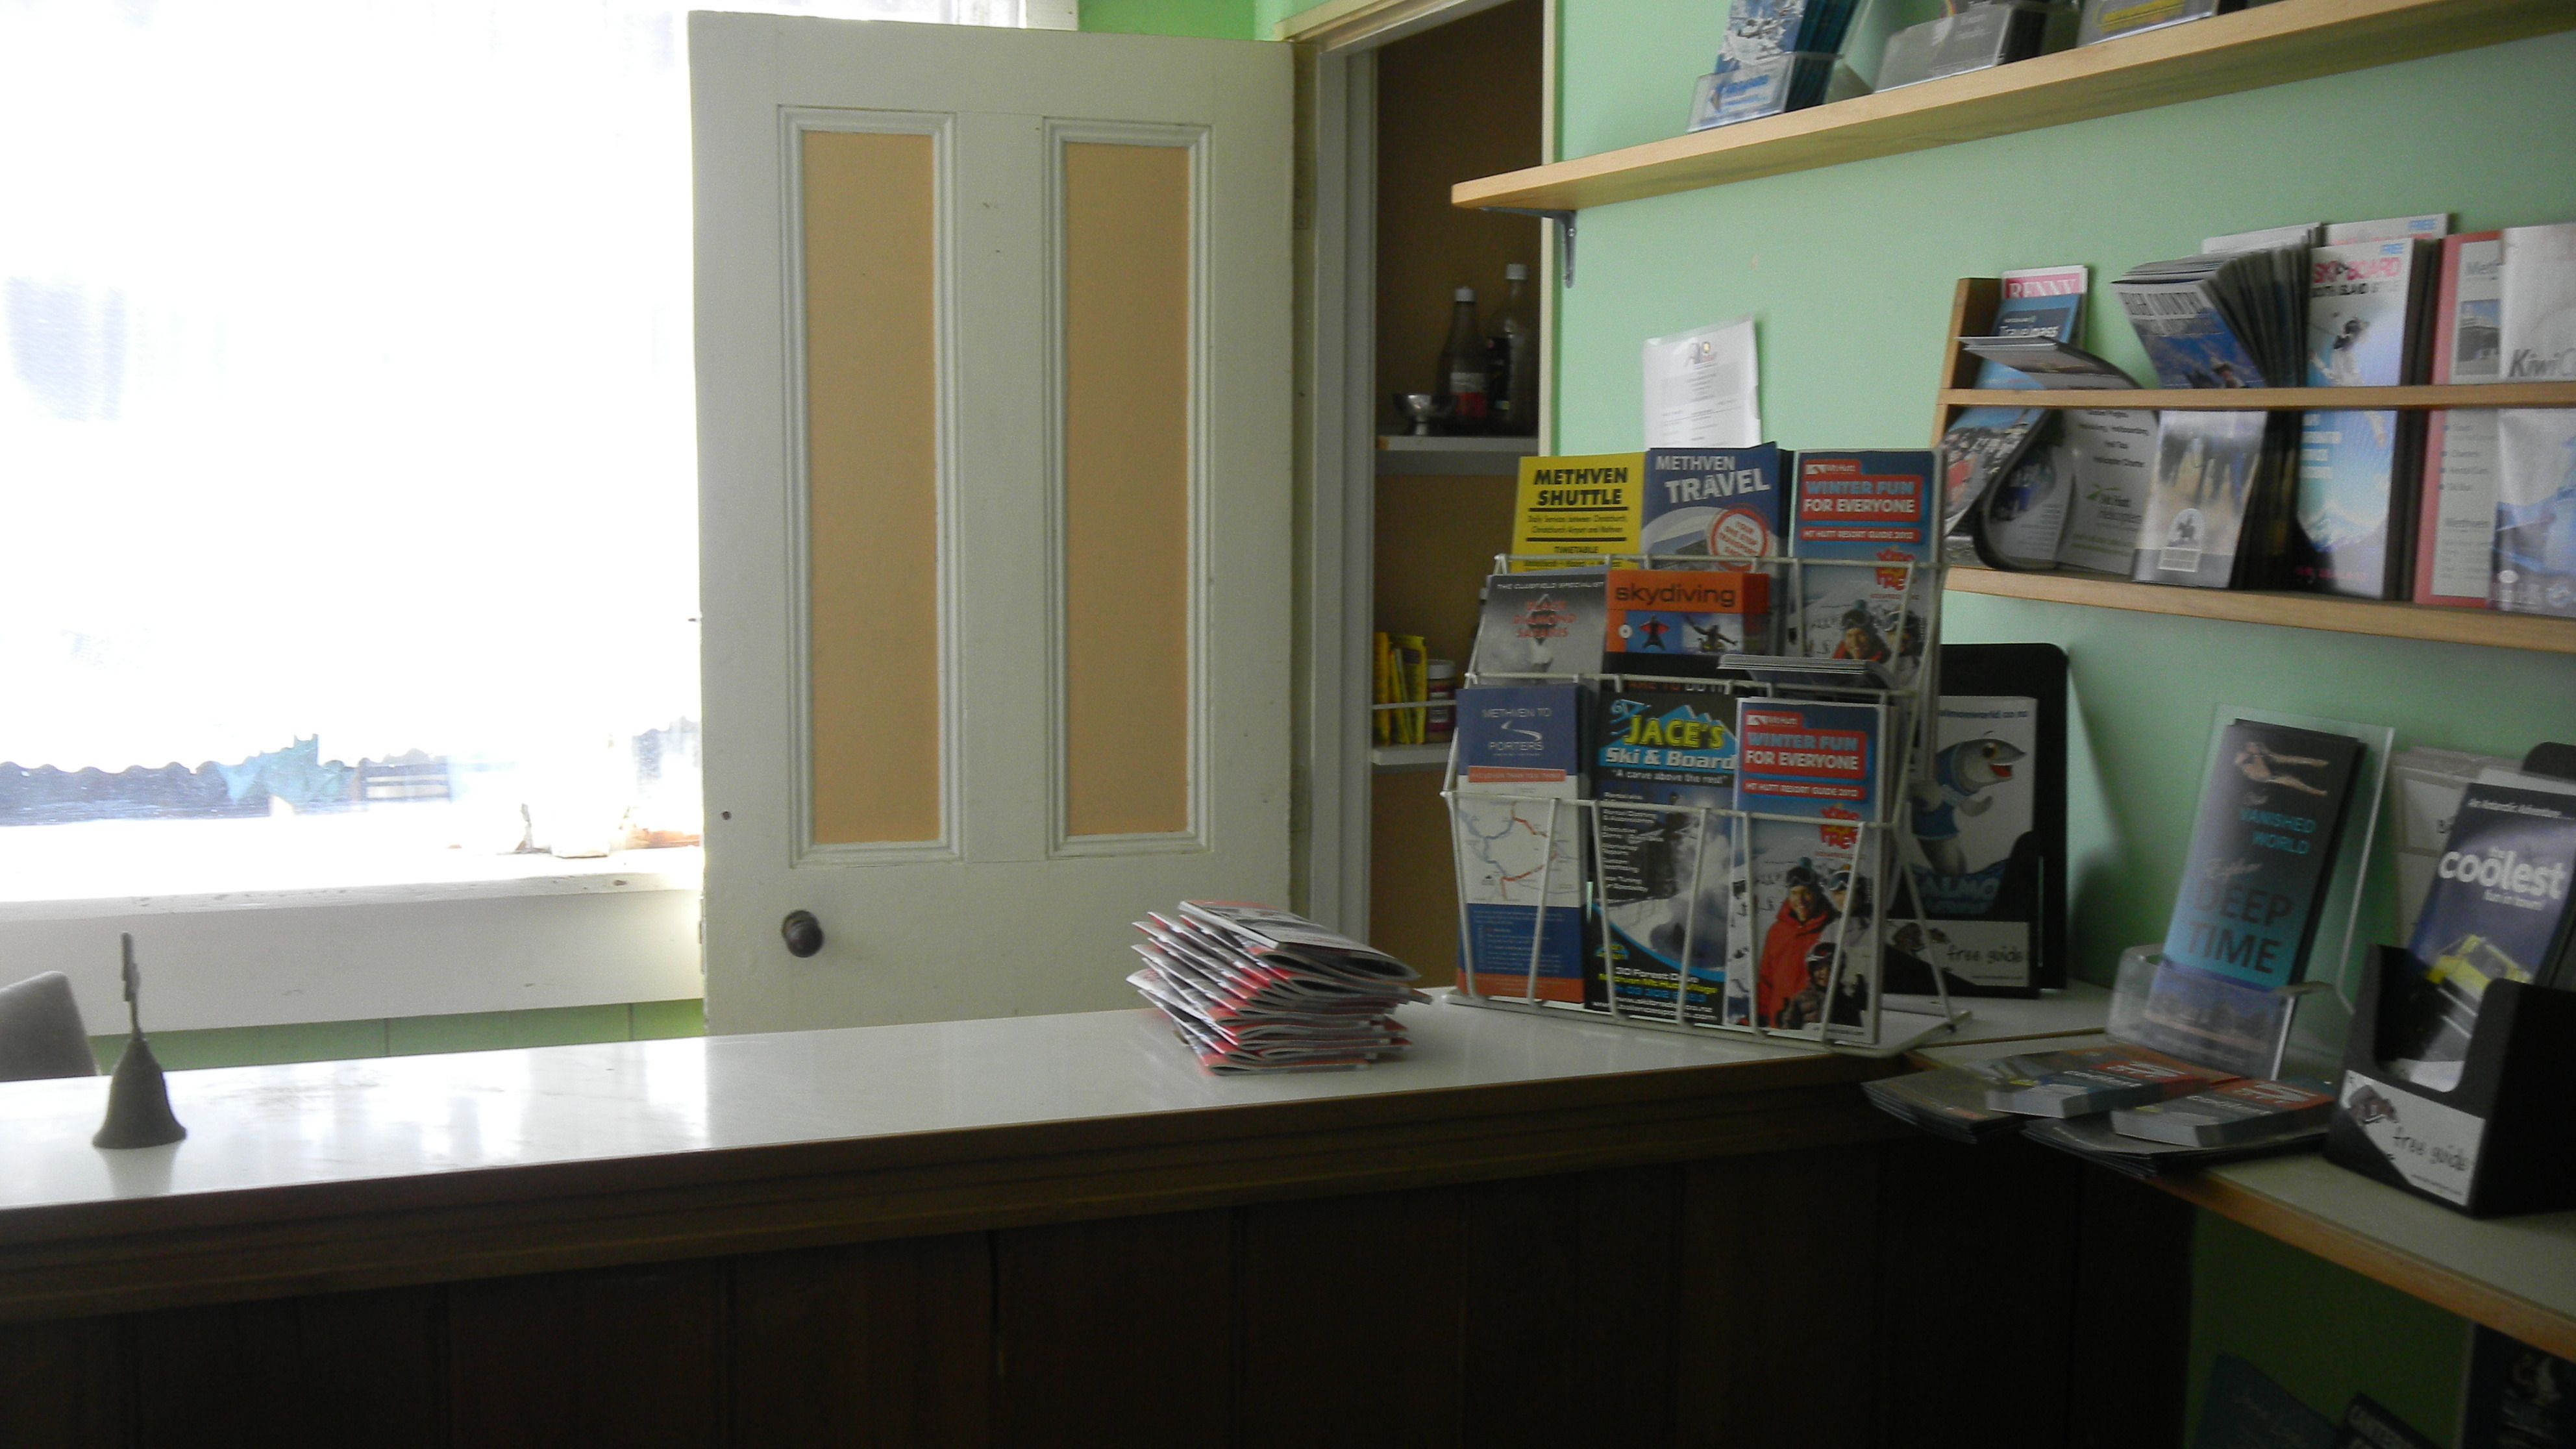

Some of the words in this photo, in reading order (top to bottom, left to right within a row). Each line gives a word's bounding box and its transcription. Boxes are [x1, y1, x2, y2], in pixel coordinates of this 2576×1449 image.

[1655, 456, 1736, 471] METHVEN
[1533, 467, 1628, 485] METHVEN
[1664, 467, 1772, 504] TRAVEL
[1537, 488, 1623, 506] SHUTTLE
[1805, 480, 1873, 495] WINTER
[1877, 481, 1914, 495] FUN
[1803, 498, 1833, 512] FOR
[1836, 498, 1915, 514] EVERYONE
[1615, 582, 1737, 608] skydiving
[1481, 708, 1535, 718] METHVEN
[1537, 707, 1553, 717] TO
[1622, 714, 1725, 750] JACE'S
[1747, 732, 1816, 749] WINTER
[1820, 735, 1859, 751] FUN
[1489, 741, 1544, 751] PORTERS
[1605, 747, 1641, 765] Ski
[1643, 749, 1661, 766] &
[1666, 750, 1738, 770] Board
[1744, 749, 1776, 765] FOR
[1778, 752, 1859, 771] EVERYONE
[1627, 771, 1652, 780] carve
[1653, 772, 1682, 782] above
[1685, 774, 1701, 783] the
[1781, 784, 1810, 794] RESORT
[2240, 807, 2316, 834] VANISHED
[2252, 830, 2310, 855] WORLD
[2437, 850, 2566, 900] coolest
[2194, 876, 2293, 927] DEEP
[1948, 944, 1980, 961] free
[1987, 945, 2024, 964] guide
[2187, 921, 2283, 974] TIME
[2429, 1143, 2470, 1171] guide
